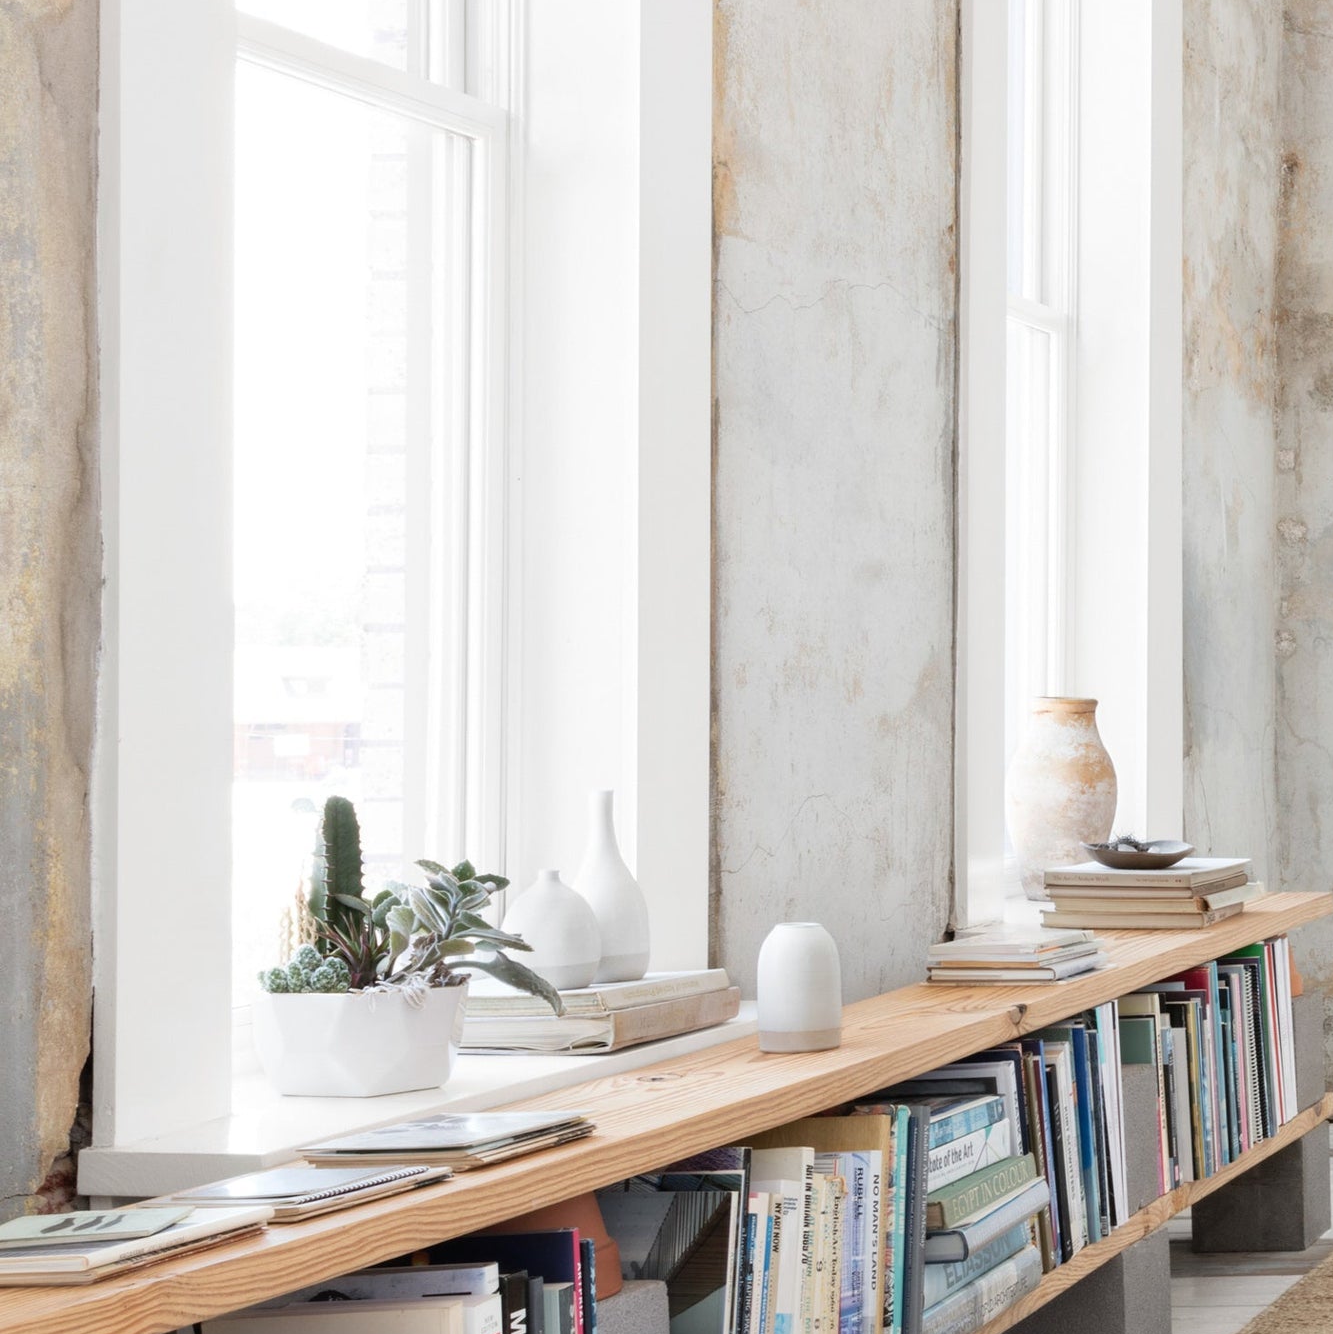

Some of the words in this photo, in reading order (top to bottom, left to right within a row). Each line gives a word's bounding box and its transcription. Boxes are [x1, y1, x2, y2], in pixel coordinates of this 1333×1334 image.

[921, 1125, 930, 1162] Modern
[944, 1154, 951, 1168] of
[951, 1149, 962, 1165] the
[963, 1141, 974, 1160] Art
[921, 1166, 929, 1179] Art
[1065, 1134, 1076, 1201] SCHWITTERS
[806, 1182, 813, 1192] IN
[856, 1167, 864, 1217] RUBELL
[872, 1174, 880, 1197] NO
[952, 1185, 980, 1220] EGYPT
[980, 1180, 993, 1201] IN
[993, 1160, 1029, 1195] COLOUR
[773, 1215, 781, 1230] ART
[774, 1203, 782, 1213] NY
[803, 1194, 812, 1227] BRITAIN
[832, 1195, 840, 1233] English
[871, 1201, 879, 1248] MAN'S
[772, 1232, 781, 1253] NOW
[829, 1258, 838, 1287] Today
[576, 1262, 584, 1325] ARTPRIZE
[760, 1286, 769, 1320] Artist's
